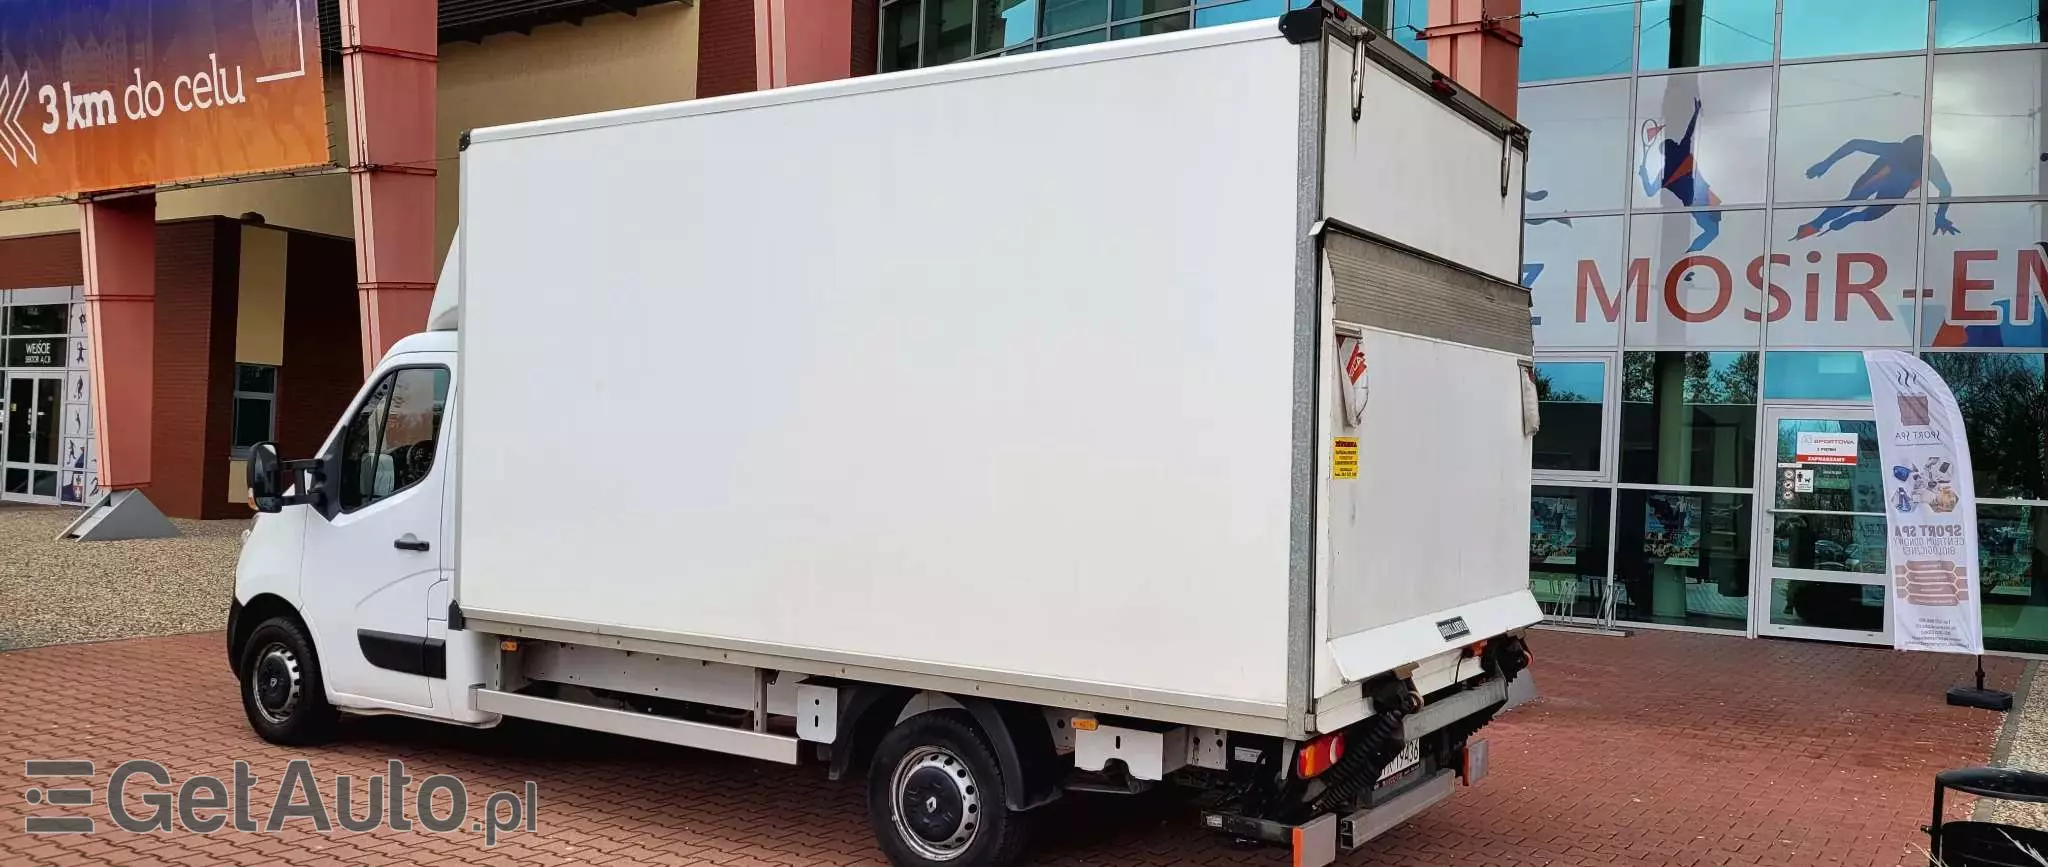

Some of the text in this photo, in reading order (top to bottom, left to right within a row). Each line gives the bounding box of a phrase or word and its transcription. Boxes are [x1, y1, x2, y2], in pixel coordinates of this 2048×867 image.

[38, 53, 245, 135] 3 km do celu
